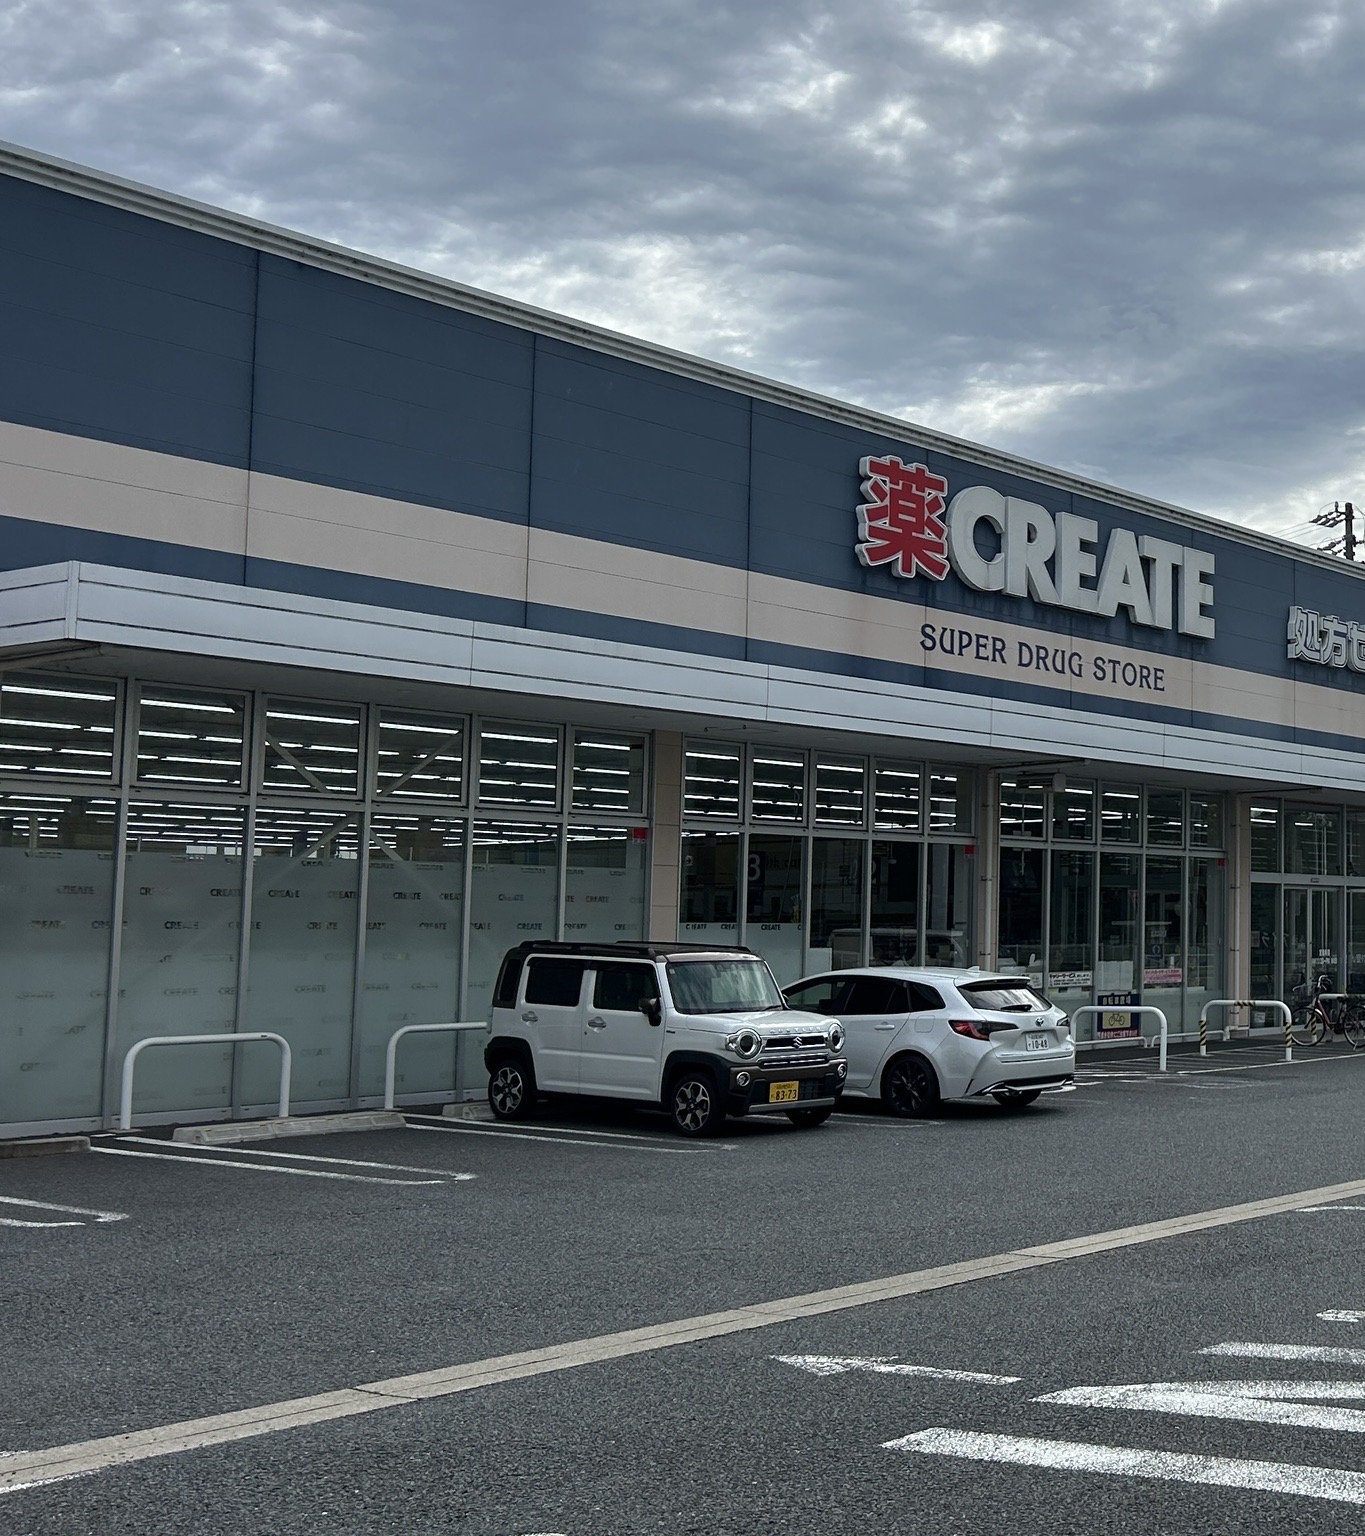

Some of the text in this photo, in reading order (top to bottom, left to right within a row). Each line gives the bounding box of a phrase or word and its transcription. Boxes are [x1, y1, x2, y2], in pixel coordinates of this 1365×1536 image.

[855, 455, 1215, 640] 薬 CREATE
[919, 623, 1166, 692] SUPER DRUG STORE
